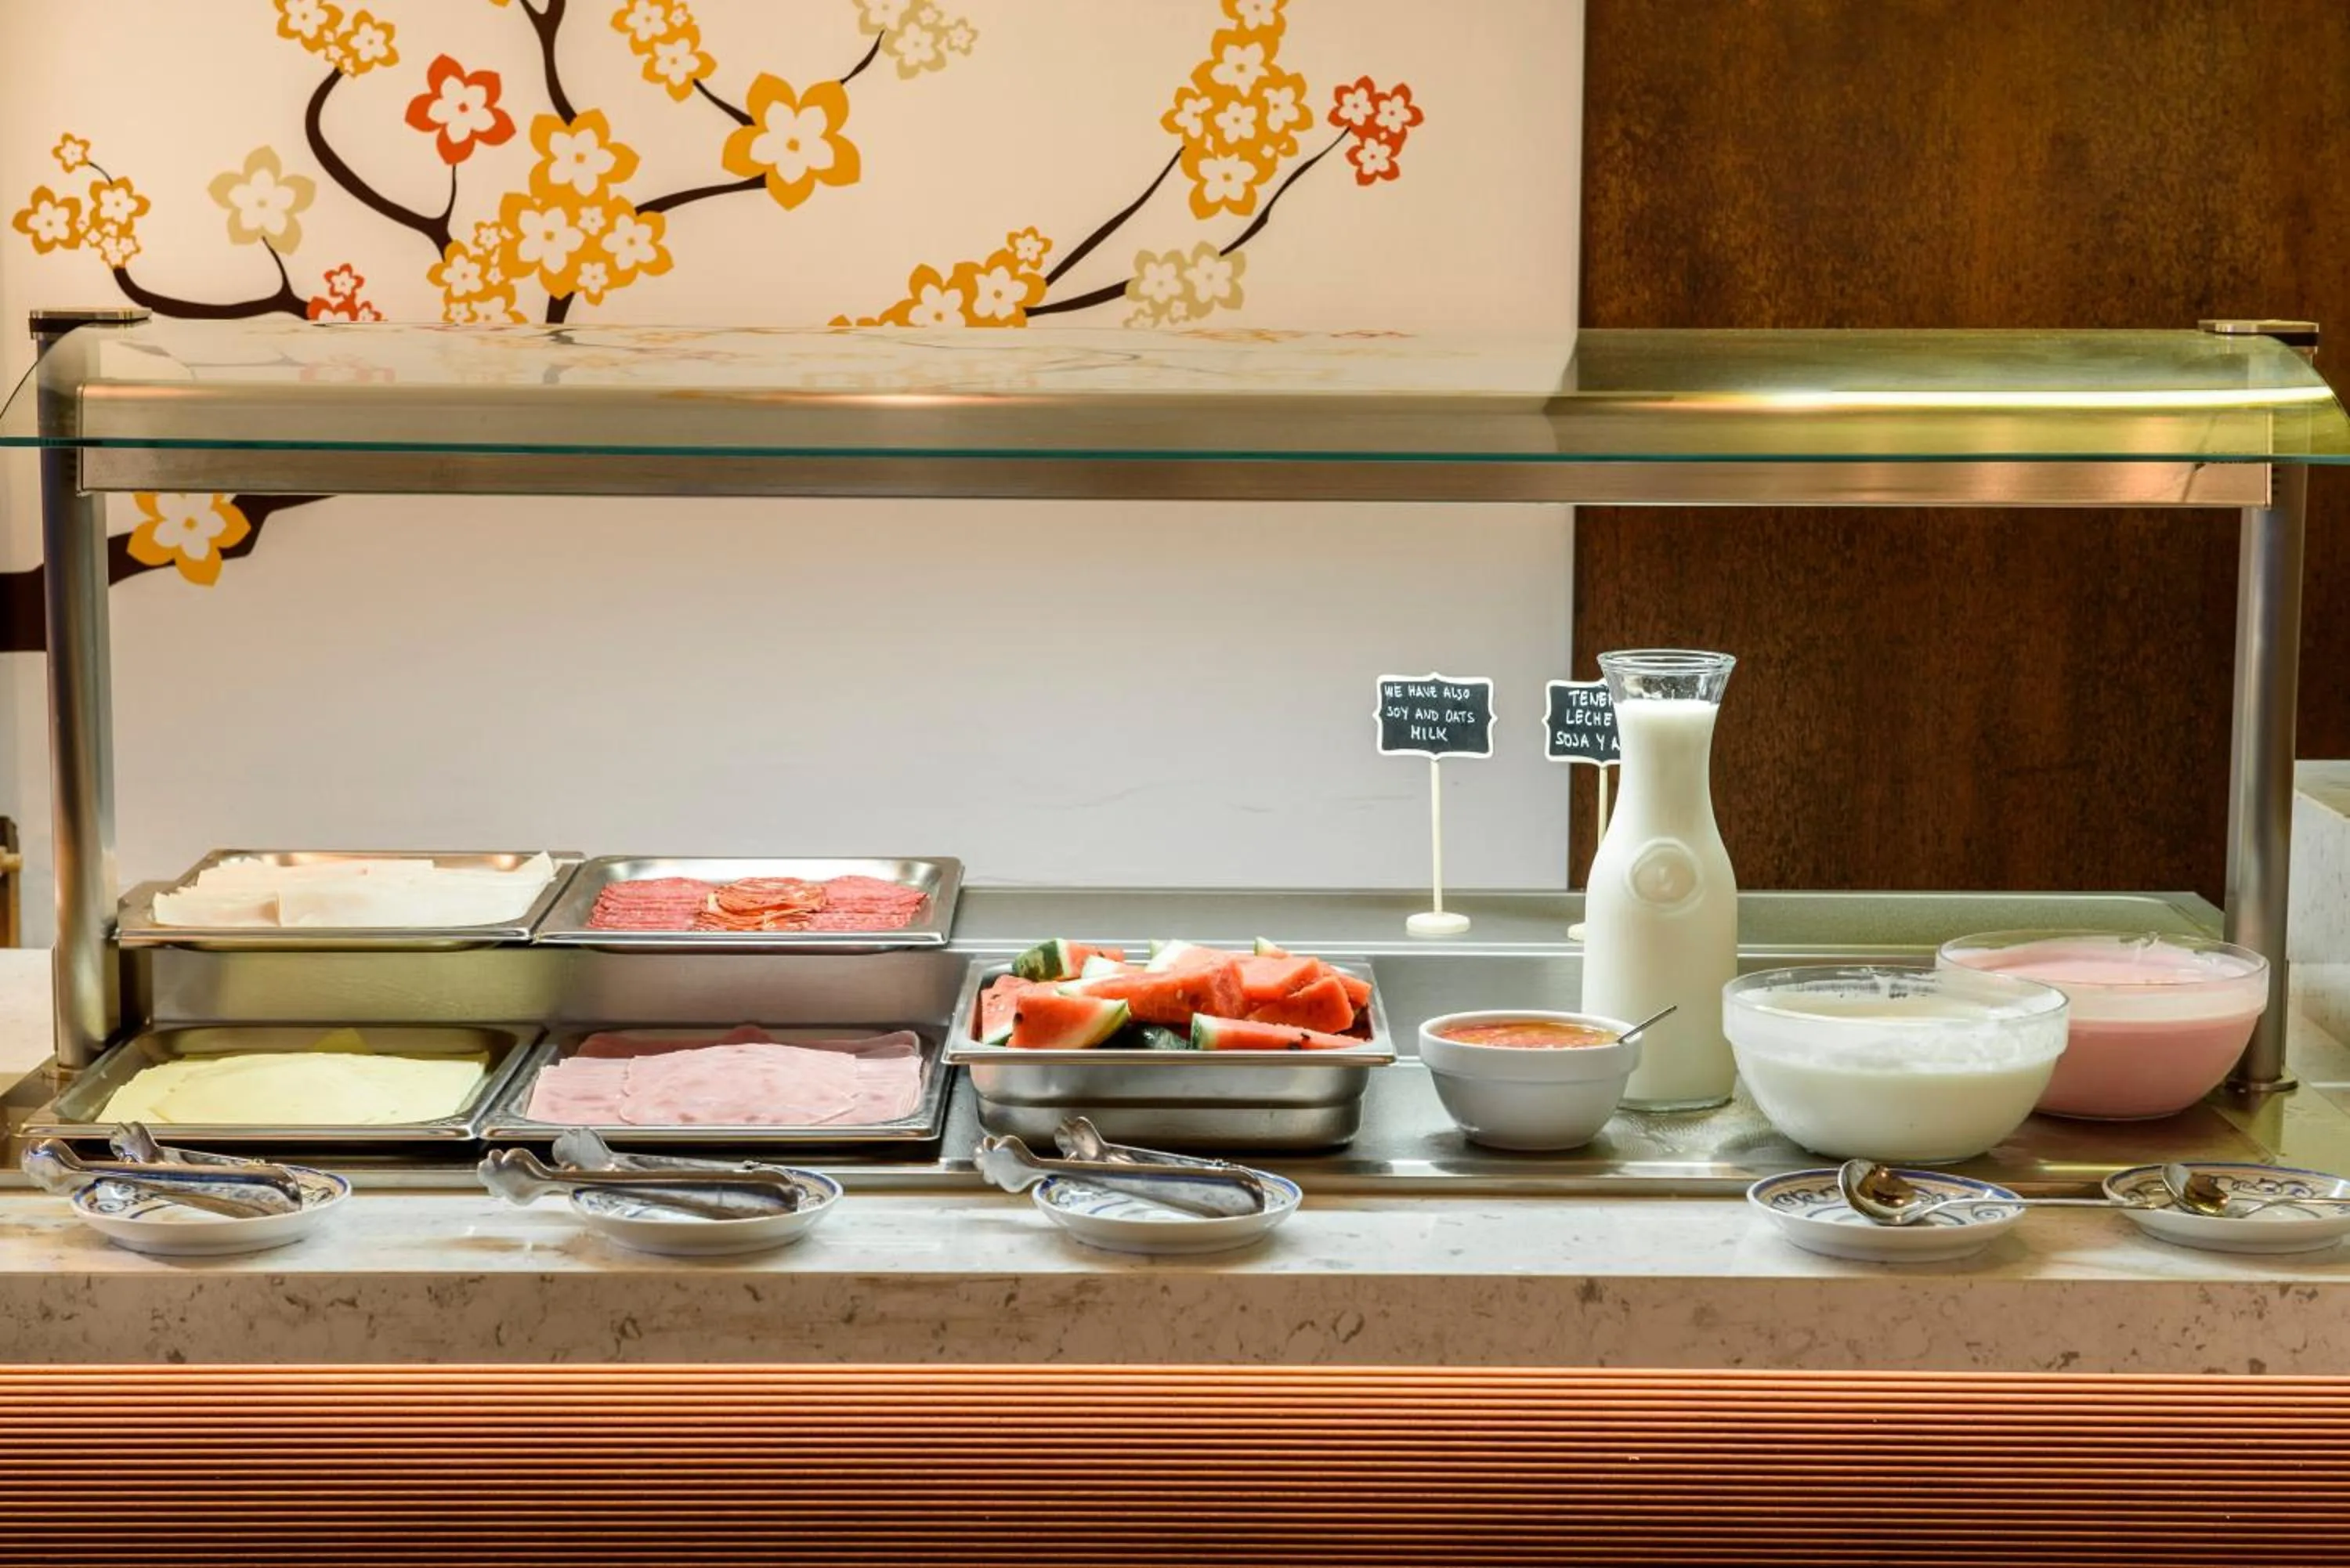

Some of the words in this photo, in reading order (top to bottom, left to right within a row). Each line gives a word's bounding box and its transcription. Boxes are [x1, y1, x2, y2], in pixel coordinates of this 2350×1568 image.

[1384, 684, 1402, 698] WE
[1408, 685, 1437, 698] HAVE
[1386, 706, 1408, 721] SOY
[1415, 708, 1439, 721] AND
[1445, 710, 1475, 723] OATS
[1567, 709, 1612, 726] LECHE
[1411, 724, 1448, 741] MILK
[1555, 731, 1589, 747] SOJA
[1596, 733, 1605, 751] Y
